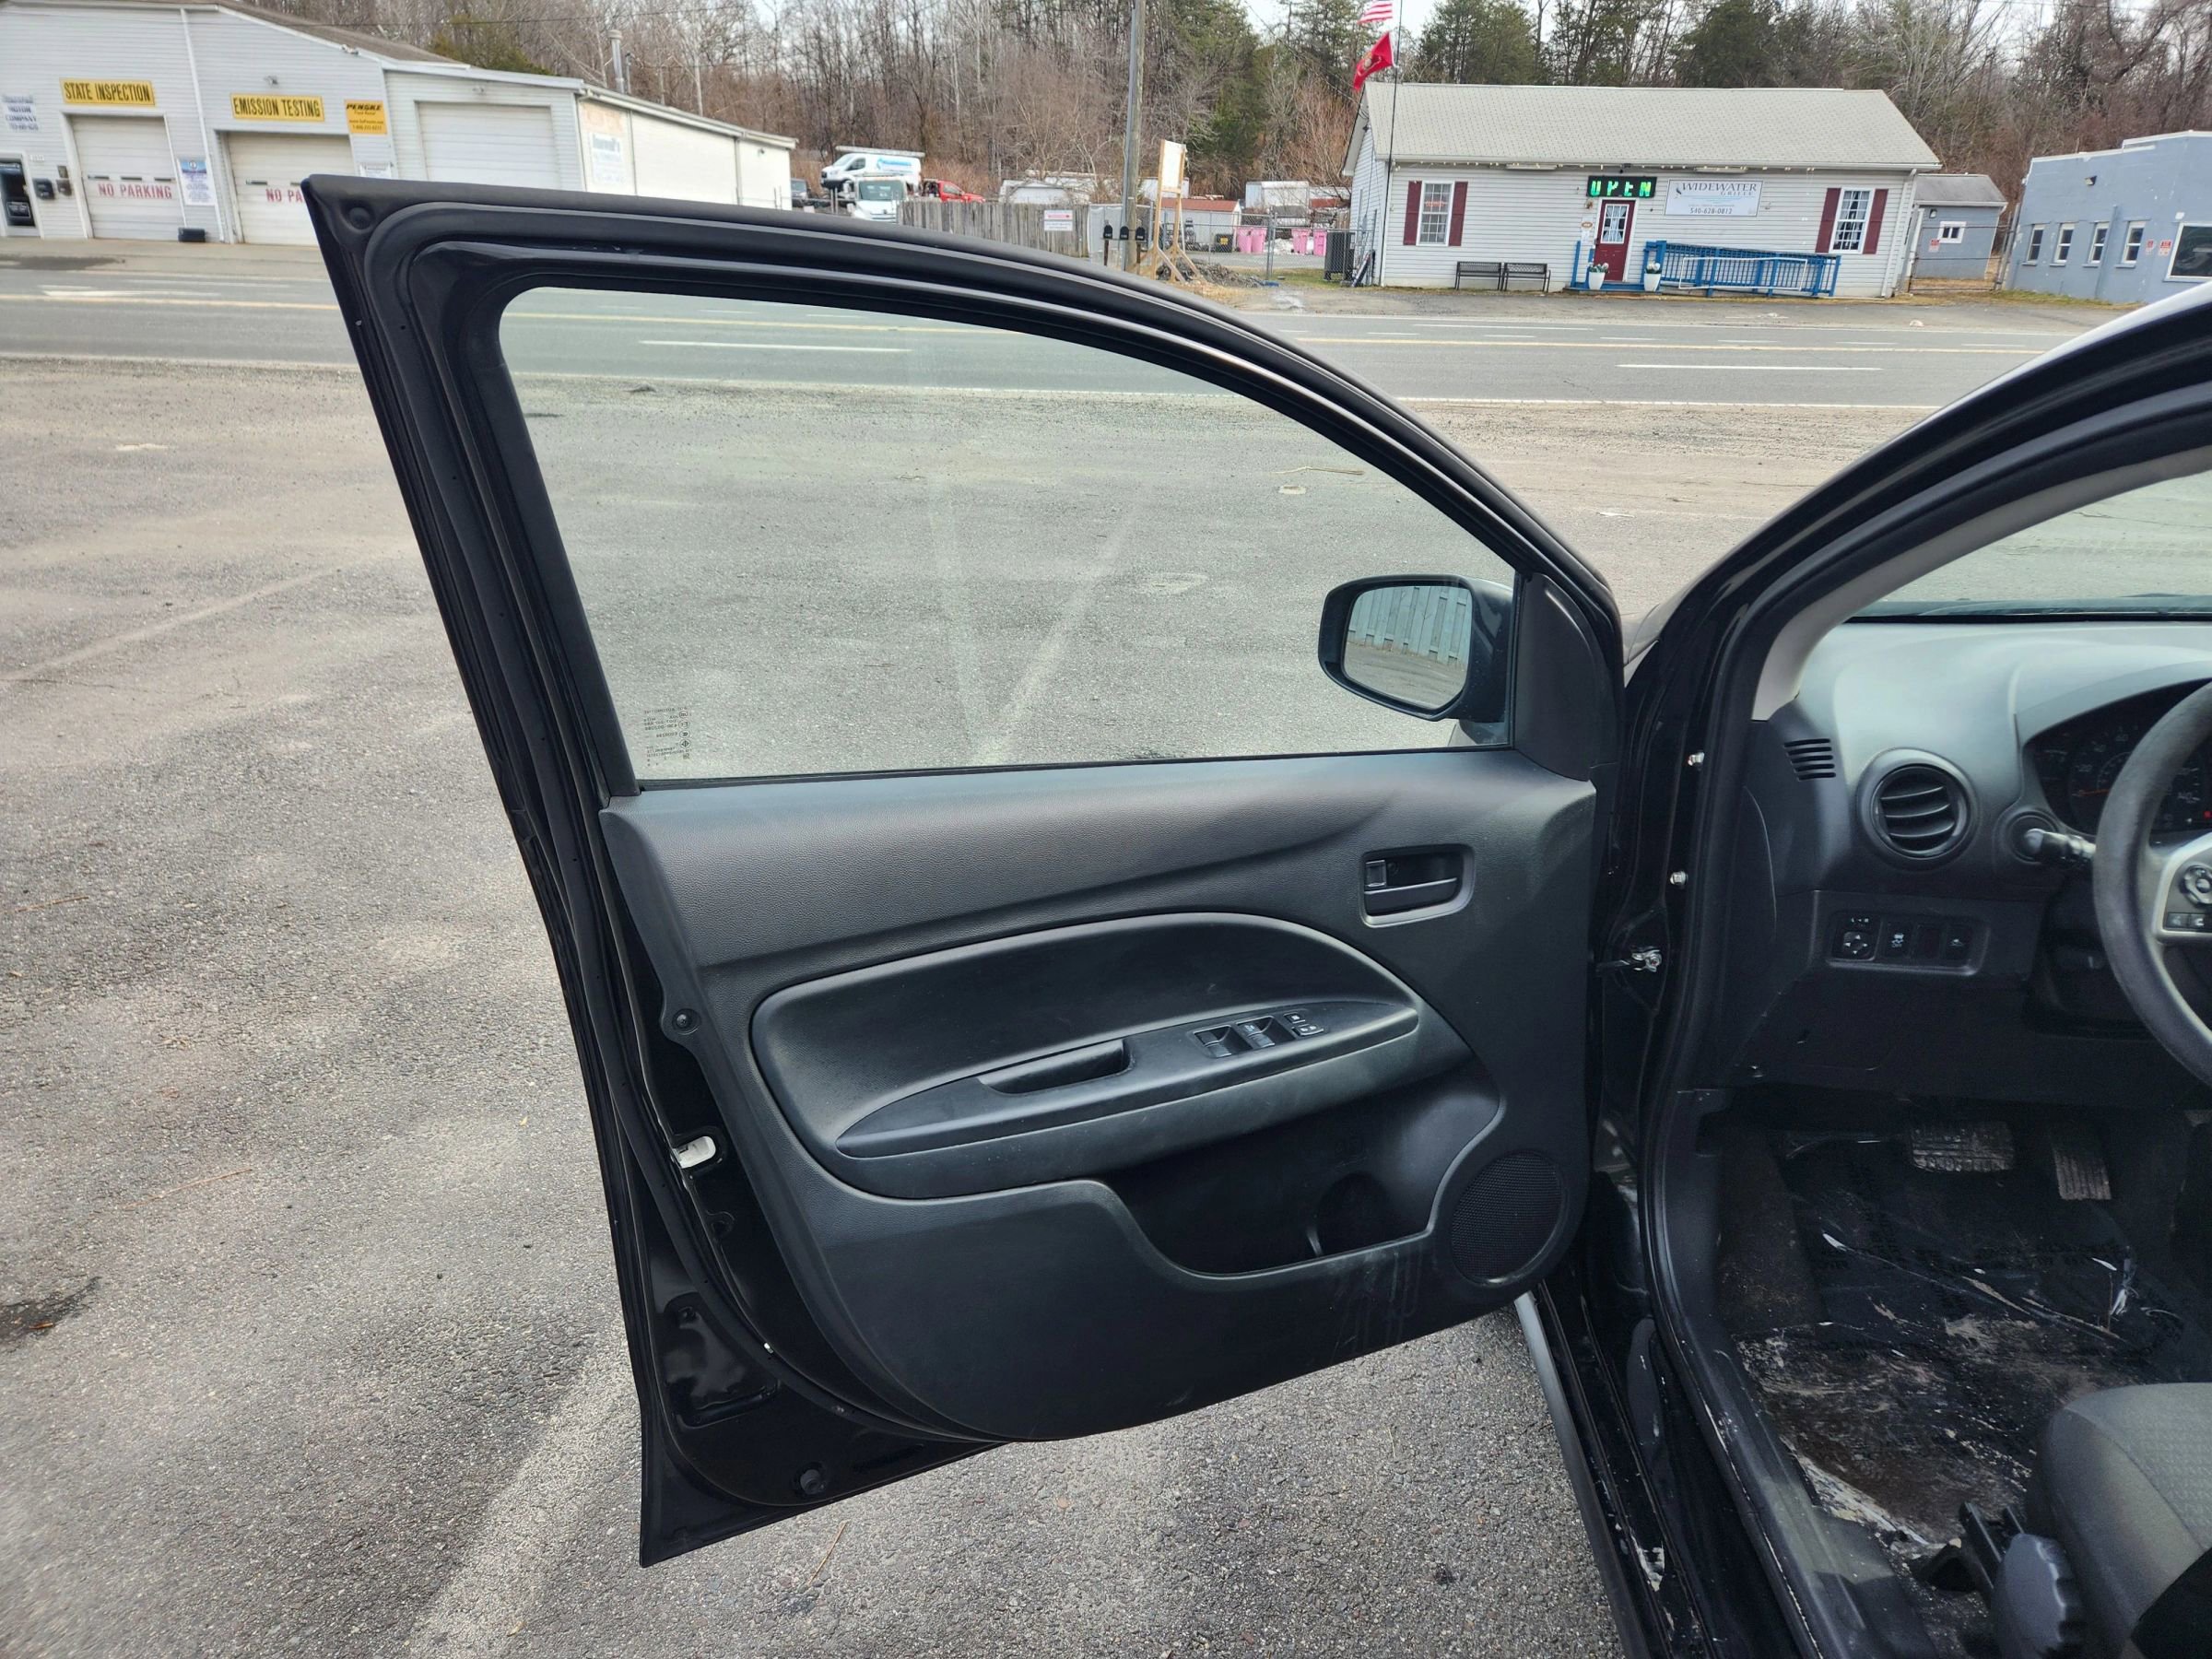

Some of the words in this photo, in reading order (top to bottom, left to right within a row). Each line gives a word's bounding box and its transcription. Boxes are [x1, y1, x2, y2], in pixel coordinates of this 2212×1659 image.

[64, 82, 92, 100] STATE
[95, 83, 151, 101] INSPECTION
[232, 96, 279, 116] EMISSION
[281, 100, 321, 118] TESTING
[99, 184, 114, 196] NO
[120, 184, 172, 199] PARKING
[1682, 182, 1757, 192] WIDEWATER
[265, 188, 282, 202] NO
